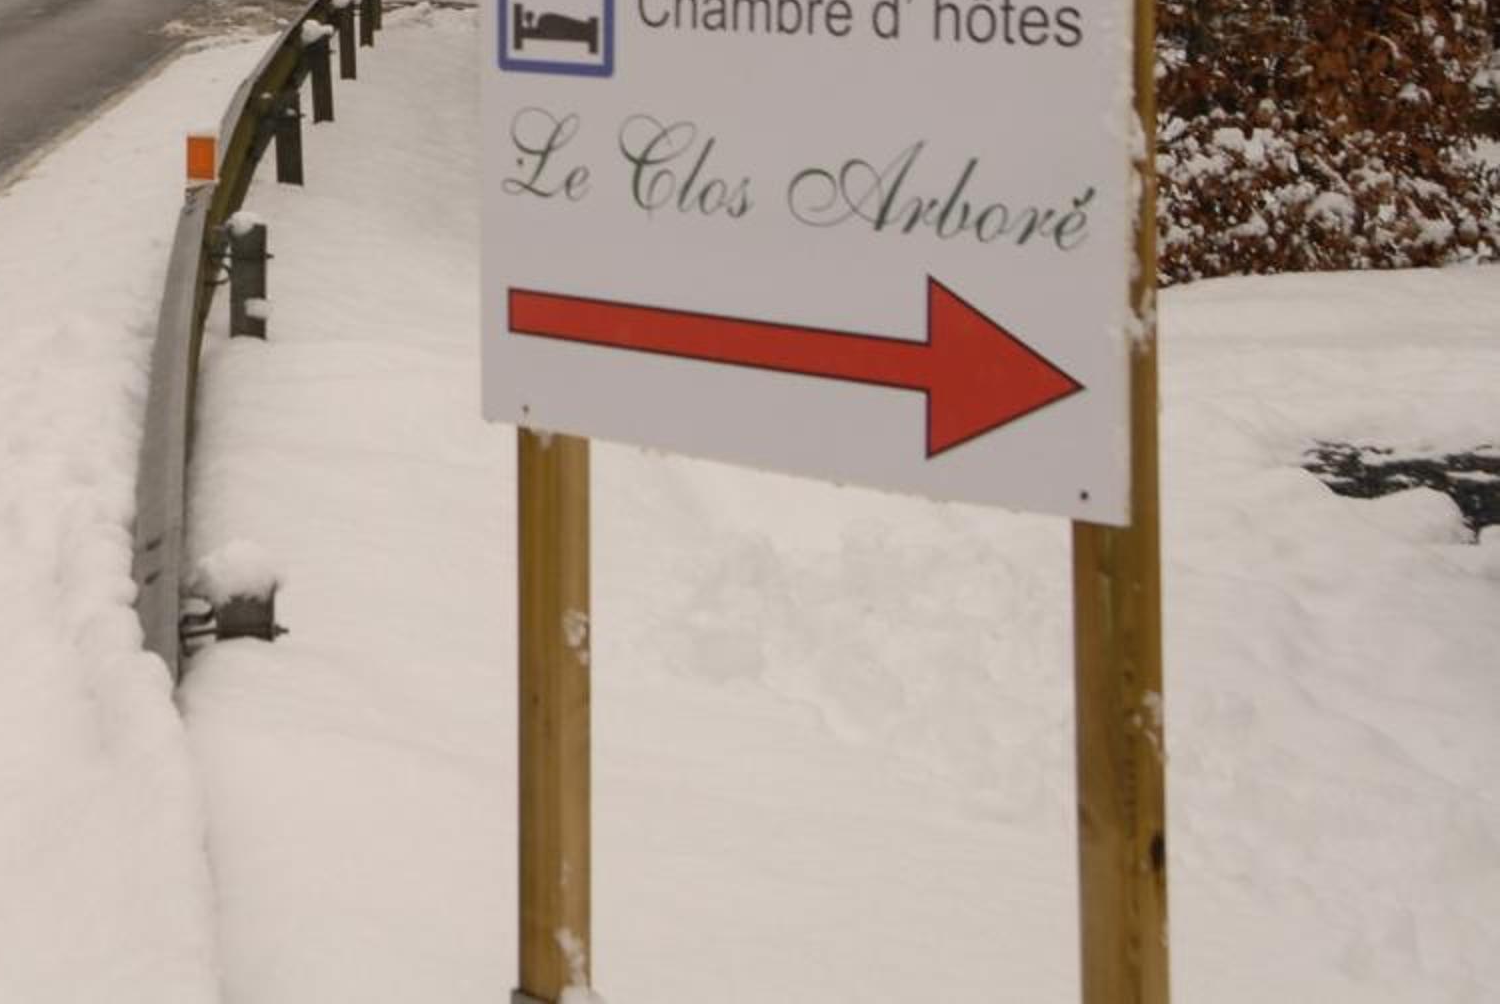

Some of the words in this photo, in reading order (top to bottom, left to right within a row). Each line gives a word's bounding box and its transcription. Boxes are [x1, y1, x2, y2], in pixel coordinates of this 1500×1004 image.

[501, 105, 591, 201] Le
[617, 113, 755, 219] Clos
[787, 140, 1097, 251] Arboré
